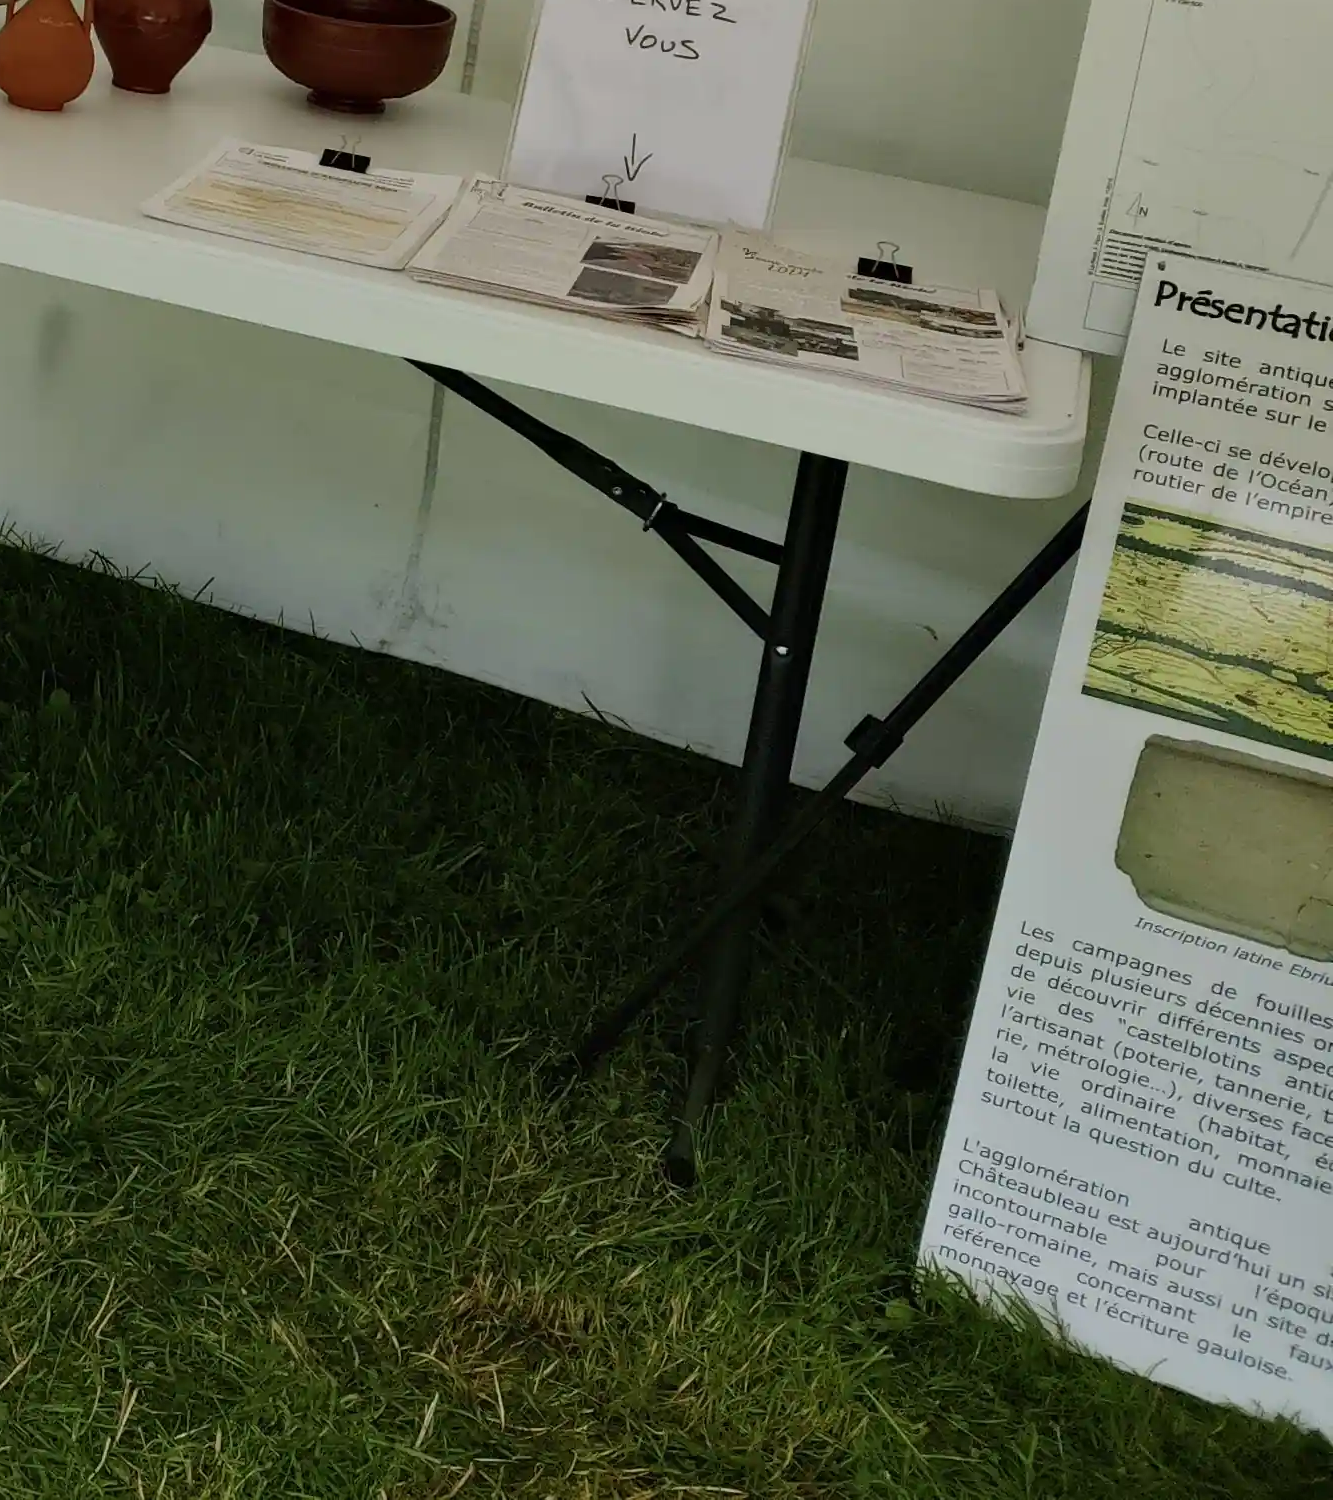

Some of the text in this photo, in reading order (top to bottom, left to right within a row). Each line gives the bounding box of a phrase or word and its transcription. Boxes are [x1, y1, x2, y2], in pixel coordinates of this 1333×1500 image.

[625, 24, 699, 60] VOUS
[1153, 279, 1333, 342] Présentati
[1161, 338, 1186, 357] Le
[1202, 350, 1242, 369] site
[1152, 380, 1327, 433] implantée sur le
[1157, 362, 1311, 407] agglomération
[1133, 468, 1206, 495] routier
[1211, 484, 1238, 503] de
[1138, 444, 1204, 473] (route
[1212, 462, 1239, 481] de
[1143, 423, 1333, 484] Celle-ci se dévelo
[1020, 920, 1333, 1030] Les campagnes de fouilles
[1133, 916, 1229, 956] Inscription
[1233, 947, 1283, 970] latine
[1007, 986, 1036, 1005] vie
[1057, 1001, 1095, 1024] des
[1010, 964, 1036, 982] de
[1047, 975, 1147, 1017] découvrir
[1157, 1010, 1262, 1054] différents
[1015, 942, 1305, 1045] depuis plusieurs décennies
[991, 1046, 1290, 1161] la vie ordinaire (habitat,
[996, 1027, 1028, 1051] rie,
[1192, 1091, 1285, 1131] diverses
[1001, 1003, 1313, 1120] l'artisanat (poterie, tannerie,
[980, 1091, 1282, 1202] surtout la question du culte.
[987, 1067, 1065, 1109] toilette,
[1080, 1101, 1220, 1161] alimentation,
[953, 1181, 1108, 1246] incontournable
[1155, 1253, 1207, 1279] pour
[958, 1160, 1305, 1291] Châteaubleau est aujourd'hui un
[962, 1139, 1271, 1256] L'agglomération antique
[938, 1244, 1293, 1381] monnayage et l'écriture gauloise.
[943, 1224, 1042, 1268] référence
[1076, 1272, 1197, 1324] concernant
[1232, 1323, 1252, 1344] le
[948, 1203, 1307, 1339] gallo-romaine, mais aussi un site
